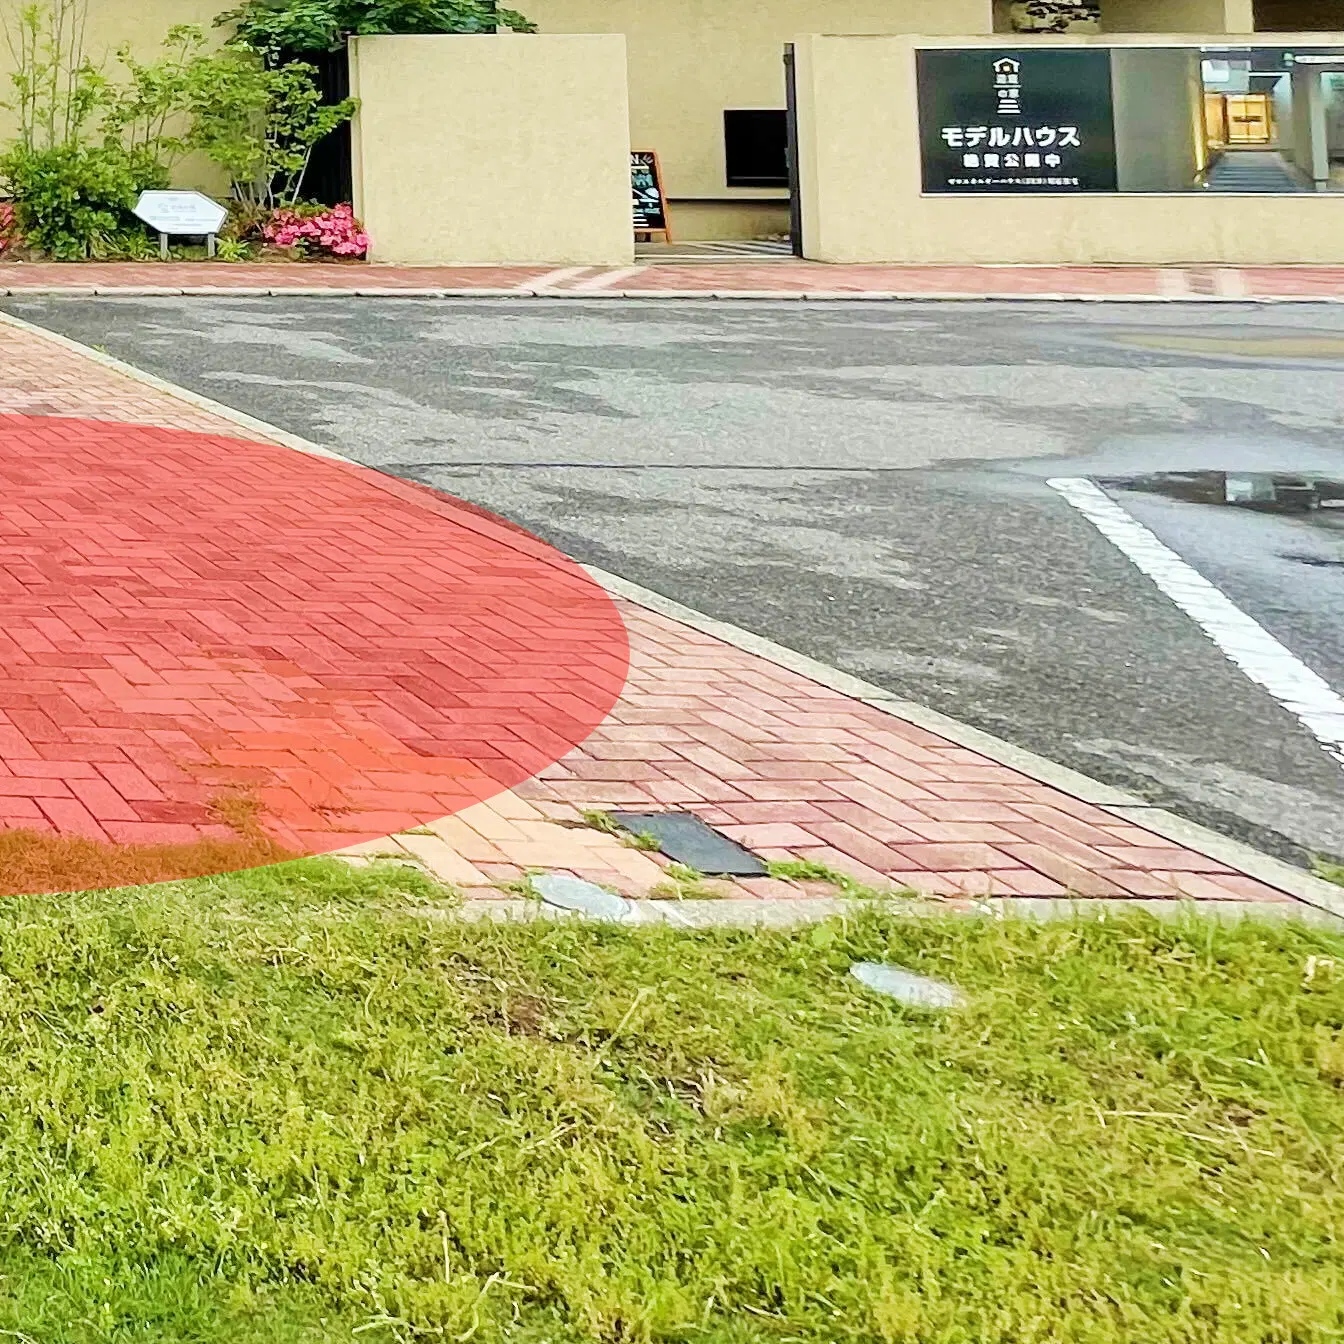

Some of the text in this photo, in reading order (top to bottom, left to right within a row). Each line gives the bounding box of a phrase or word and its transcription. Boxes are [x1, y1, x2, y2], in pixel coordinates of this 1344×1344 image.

[941, 126, 1081, 148] モデルハウス
